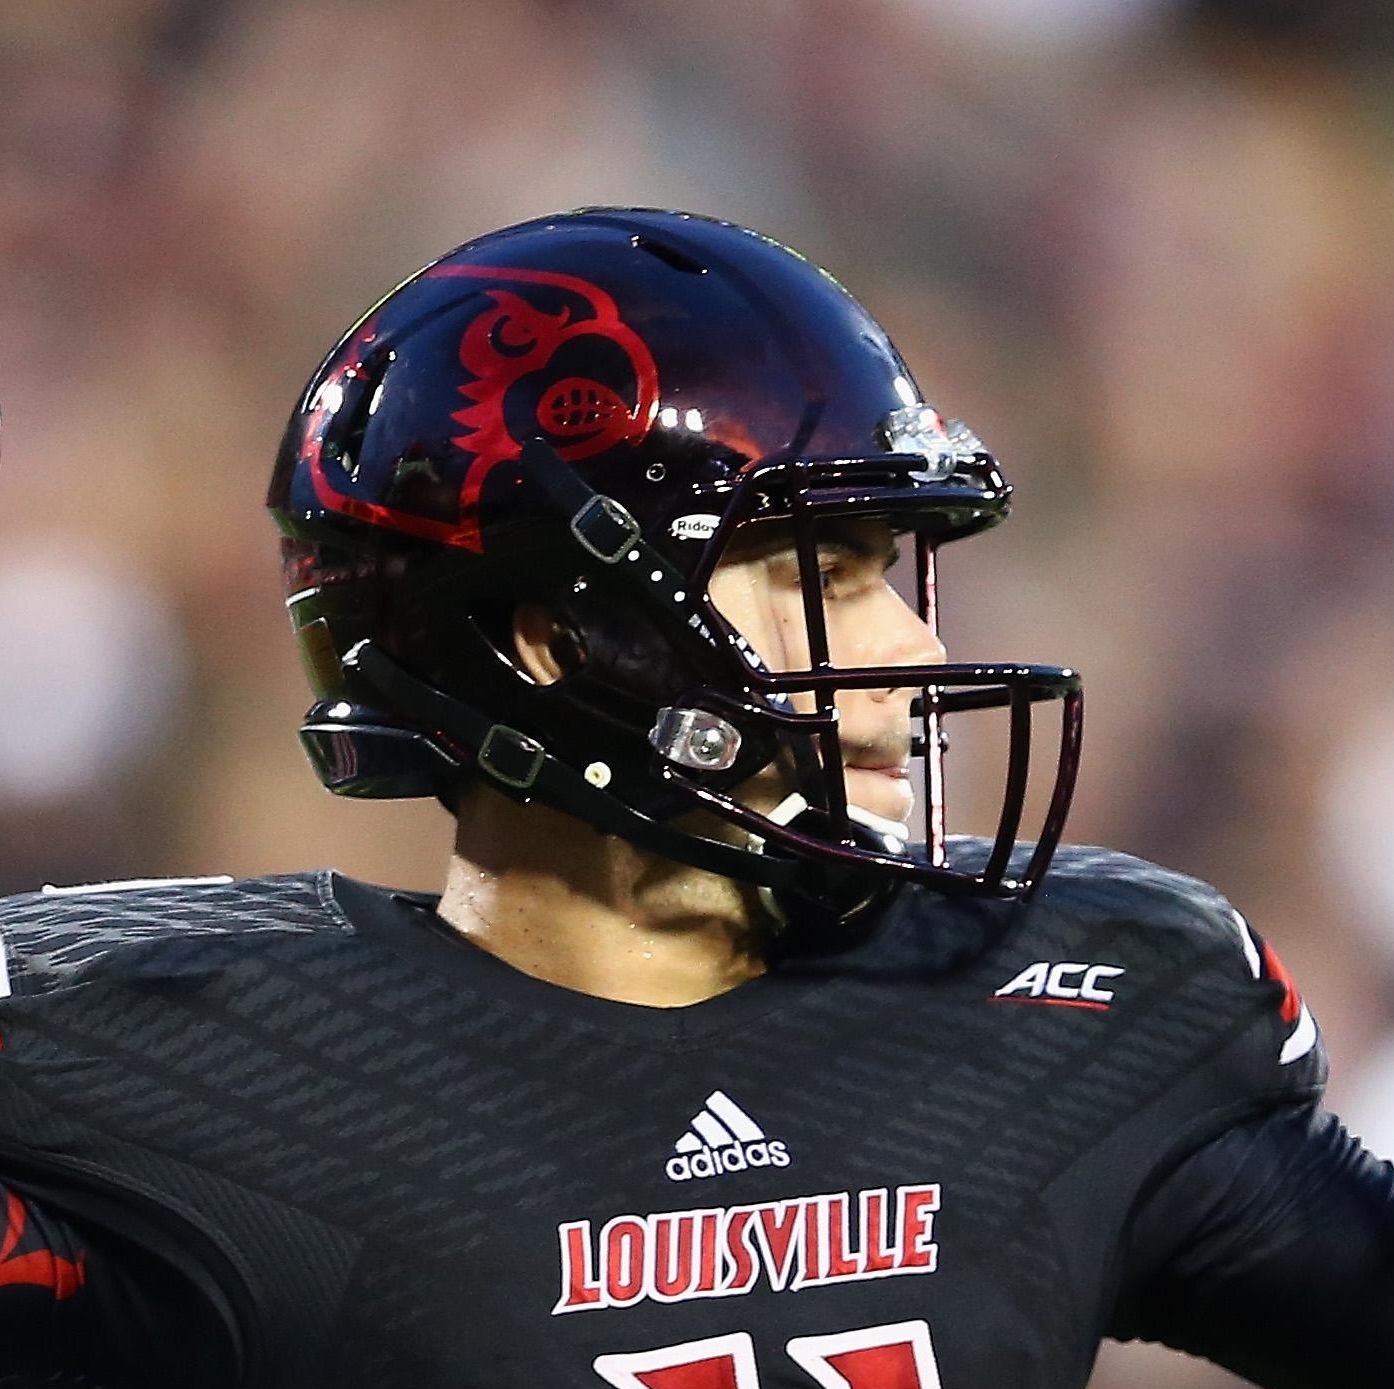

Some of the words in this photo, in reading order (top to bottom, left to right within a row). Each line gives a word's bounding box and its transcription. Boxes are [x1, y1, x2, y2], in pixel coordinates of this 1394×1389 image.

[994, 961, 1125, 1001] ACC
[665, 1138, 791, 1182] adidas
[551, 1183, 941, 1316] LOUISVILLE
